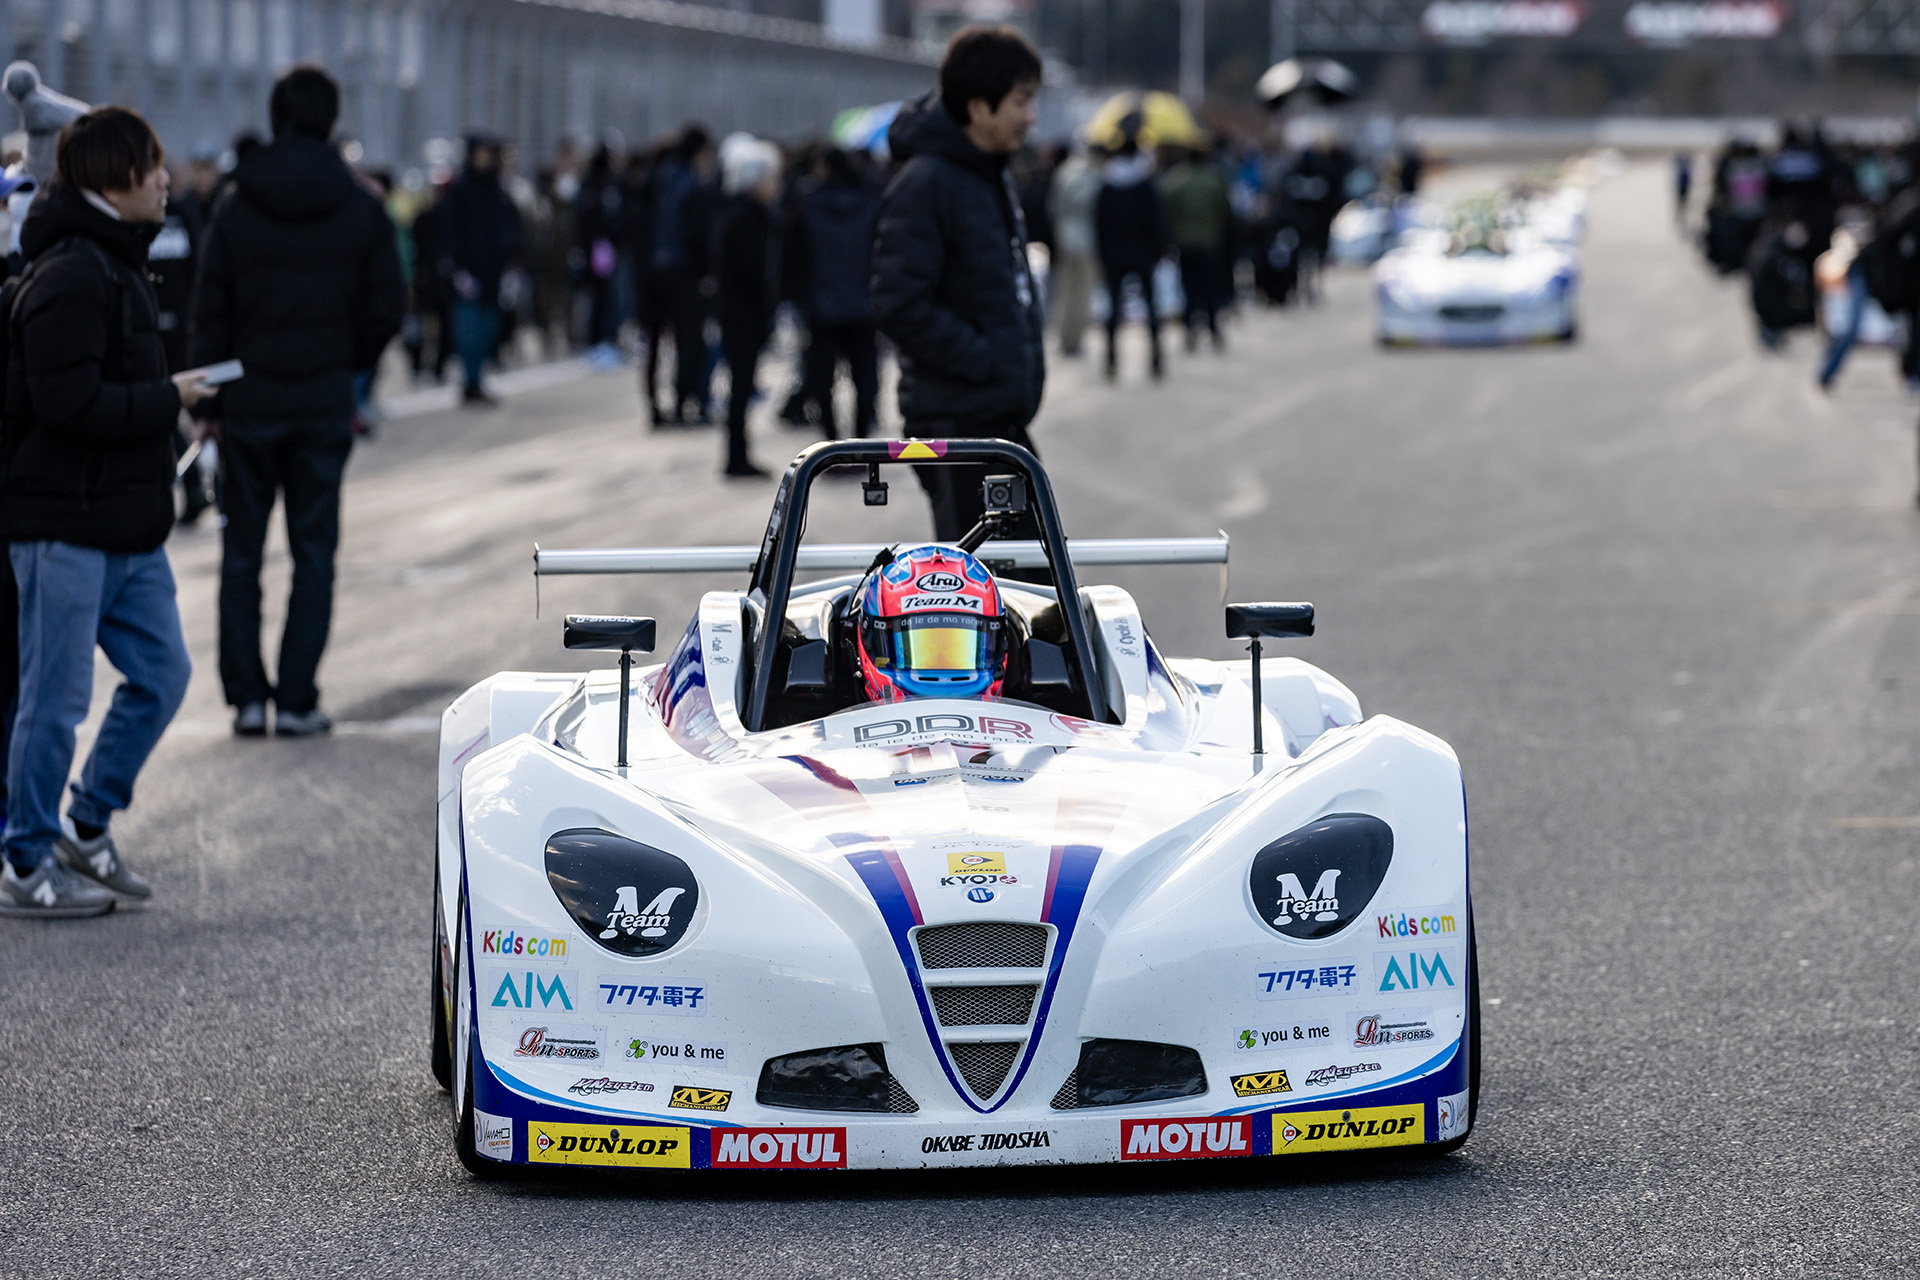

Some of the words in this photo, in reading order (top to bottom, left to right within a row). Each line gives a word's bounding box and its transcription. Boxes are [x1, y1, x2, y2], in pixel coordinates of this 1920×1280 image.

[920, 574, 958, 587] Arai
[905, 597, 952, 608] Team
[952, 596, 980, 609] M
[927, 615, 939, 624] de
[1277, 898, 1339, 915] Team
[607, 912, 670, 929] Team
[1377, 913, 1418, 938] Kids
[1421, 914, 1455, 934] com
[482, 930, 523, 954] Kids
[527, 938, 566, 956] com
[1258, 965, 1356, 993] フクダ電子
[1379, 952, 1455, 991] AIM
[491, 971, 573, 1010] AIM
[600, 984, 704, 1008] フクダ電子
[1261, 1030, 1291, 1046] you
[1293, 1027, 1304, 1040] &
[1308, 1027, 1330, 1039] me
[651, 1042, 679, 1058] you
[684, 1043, 696, 1058] &
[700, 1045, 725, 1060] me
[1271, 1085, 1291, 1093] WEAR
[1127, 1121, 1247, 1154] MOTUL
[1304, 1116, 1416, 1140] DUNLOP
[557, 1138, 679, 1155] DUNLOP
[717, 1133, 842, 1163] MOTUL
[922, 1135, 974, 1154] OKABE
[977, 1131, 1051, 1151] JIDOSHA
